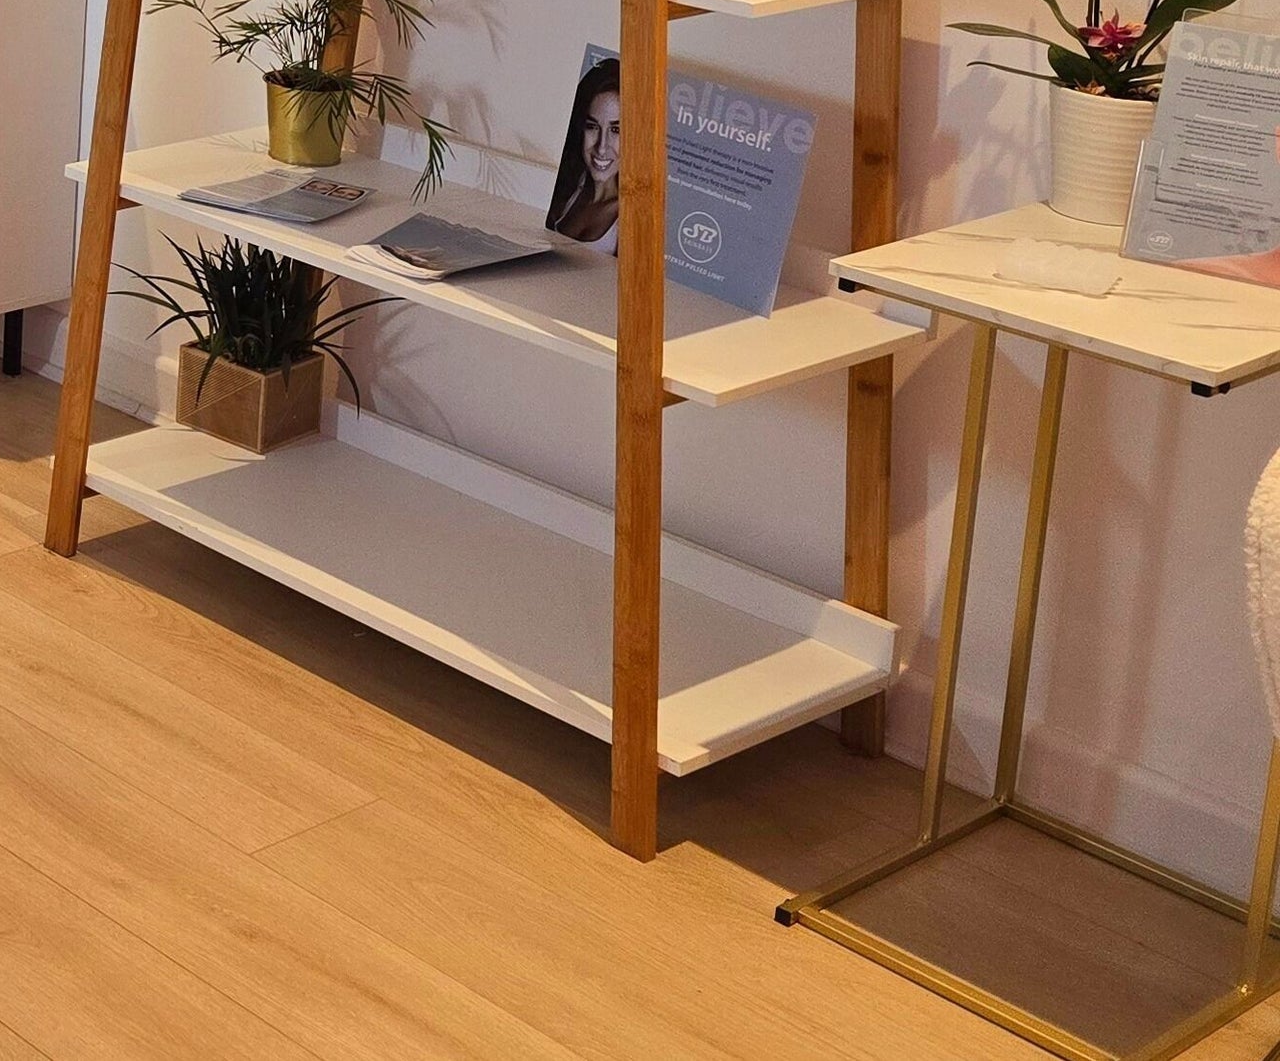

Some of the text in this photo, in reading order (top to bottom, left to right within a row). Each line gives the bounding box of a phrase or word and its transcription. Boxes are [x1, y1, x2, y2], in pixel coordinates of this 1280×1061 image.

[1187, 52, 1208, 63] Skin
[1243, 61, 1264, 72] that
[670, 82, 814, 154] elieve
[696, 116, 772, 152] yourself.
